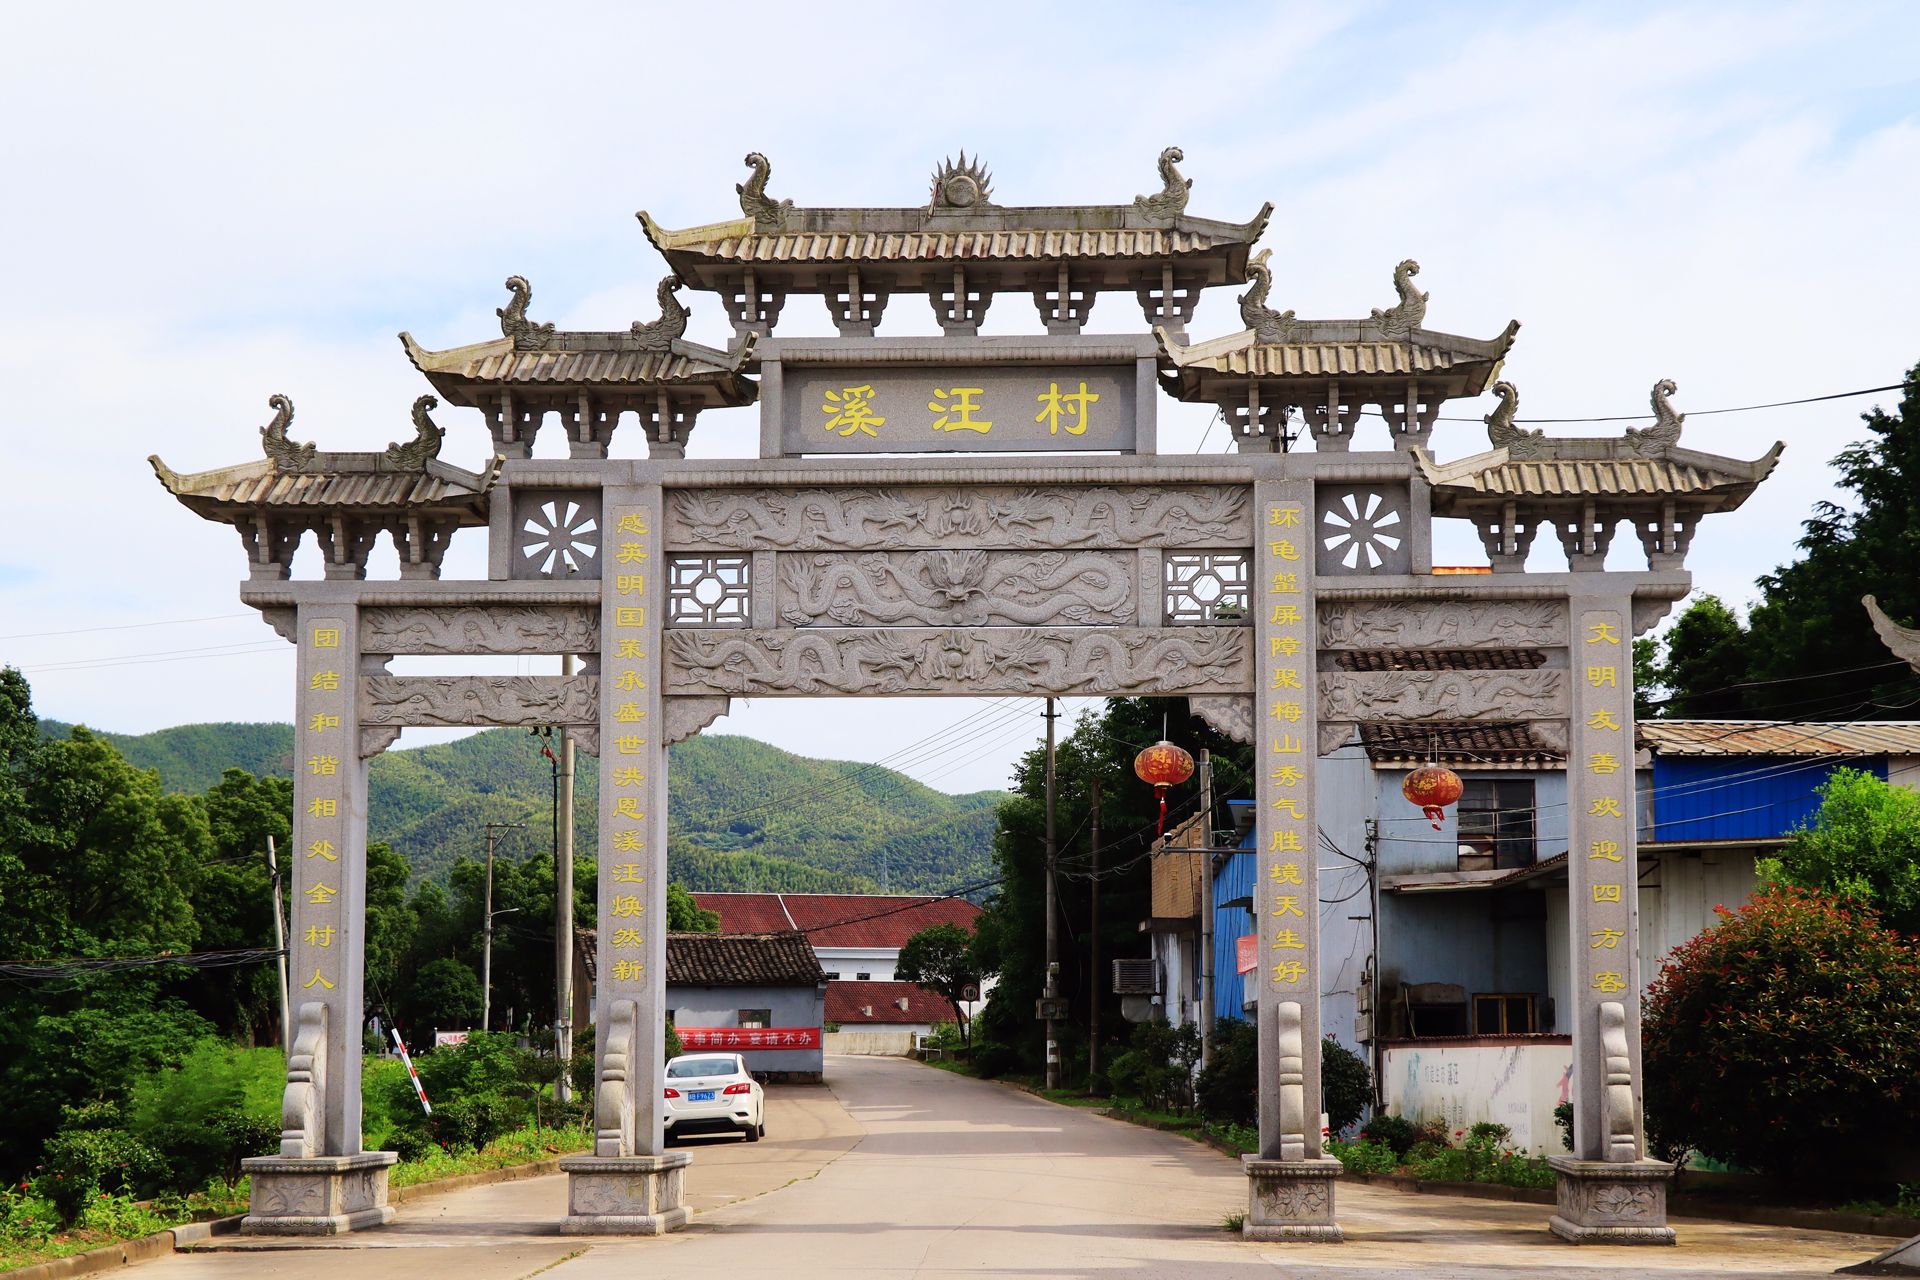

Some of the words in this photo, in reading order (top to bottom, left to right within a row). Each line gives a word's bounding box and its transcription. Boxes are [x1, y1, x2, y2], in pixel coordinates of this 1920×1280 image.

[821, 381, 1101, 438] 溪汪村
[303, 628, 341, 990] 团结和谐相处全村人
[612, 512, 649, 983] 感英明国策承盛世洪恩溪汪焕然新
[1587, 623, 1627, 994] 文明友善欢迎四方客
